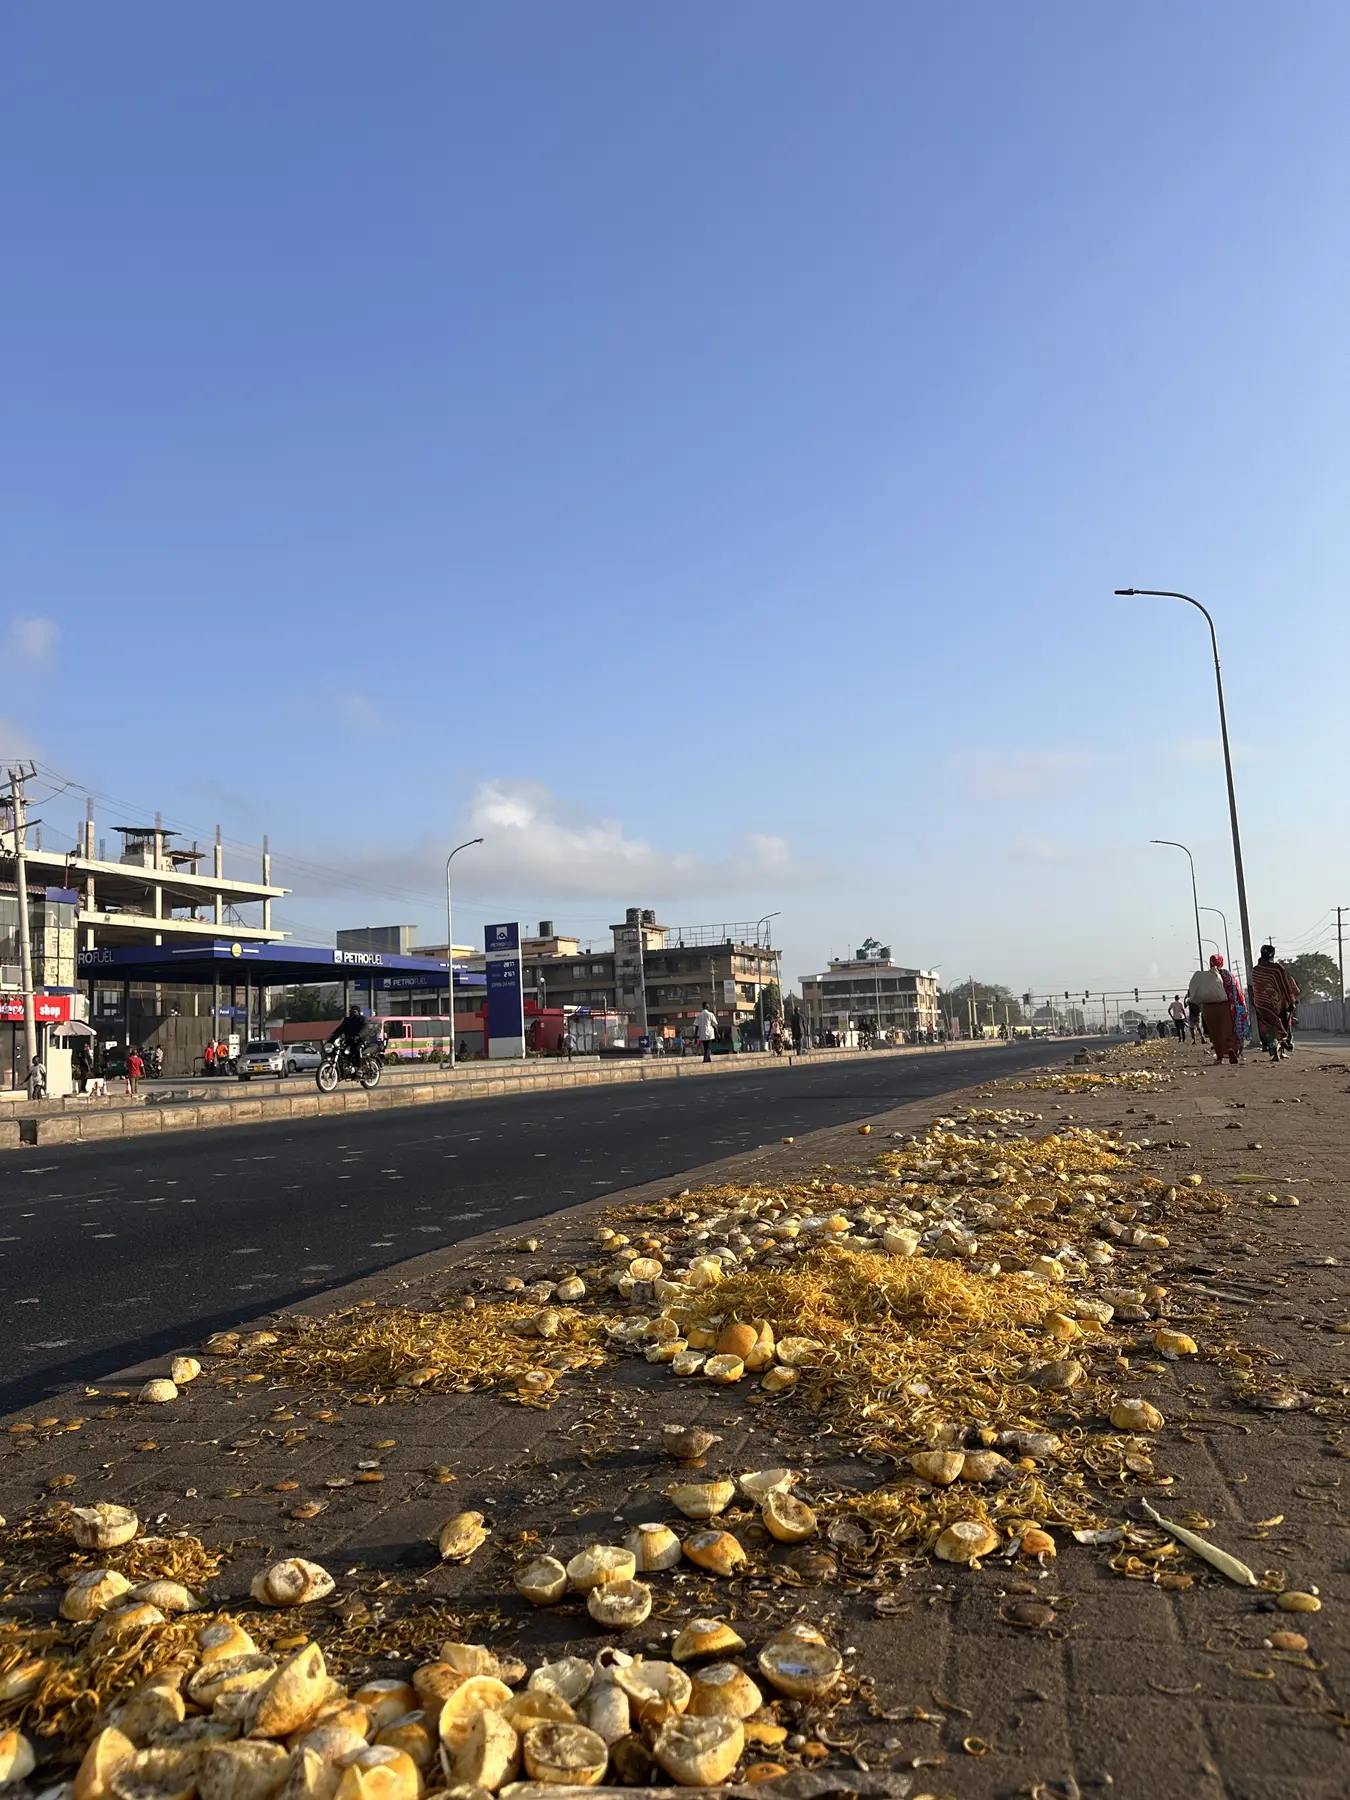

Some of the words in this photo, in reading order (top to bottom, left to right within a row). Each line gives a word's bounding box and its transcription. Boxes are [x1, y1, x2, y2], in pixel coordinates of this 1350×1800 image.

[344, 952, 383, 965] PETROFUEL
[393, 977, 428, 986] PETROFUEL
[39, 1004, 60, 1018] shop
